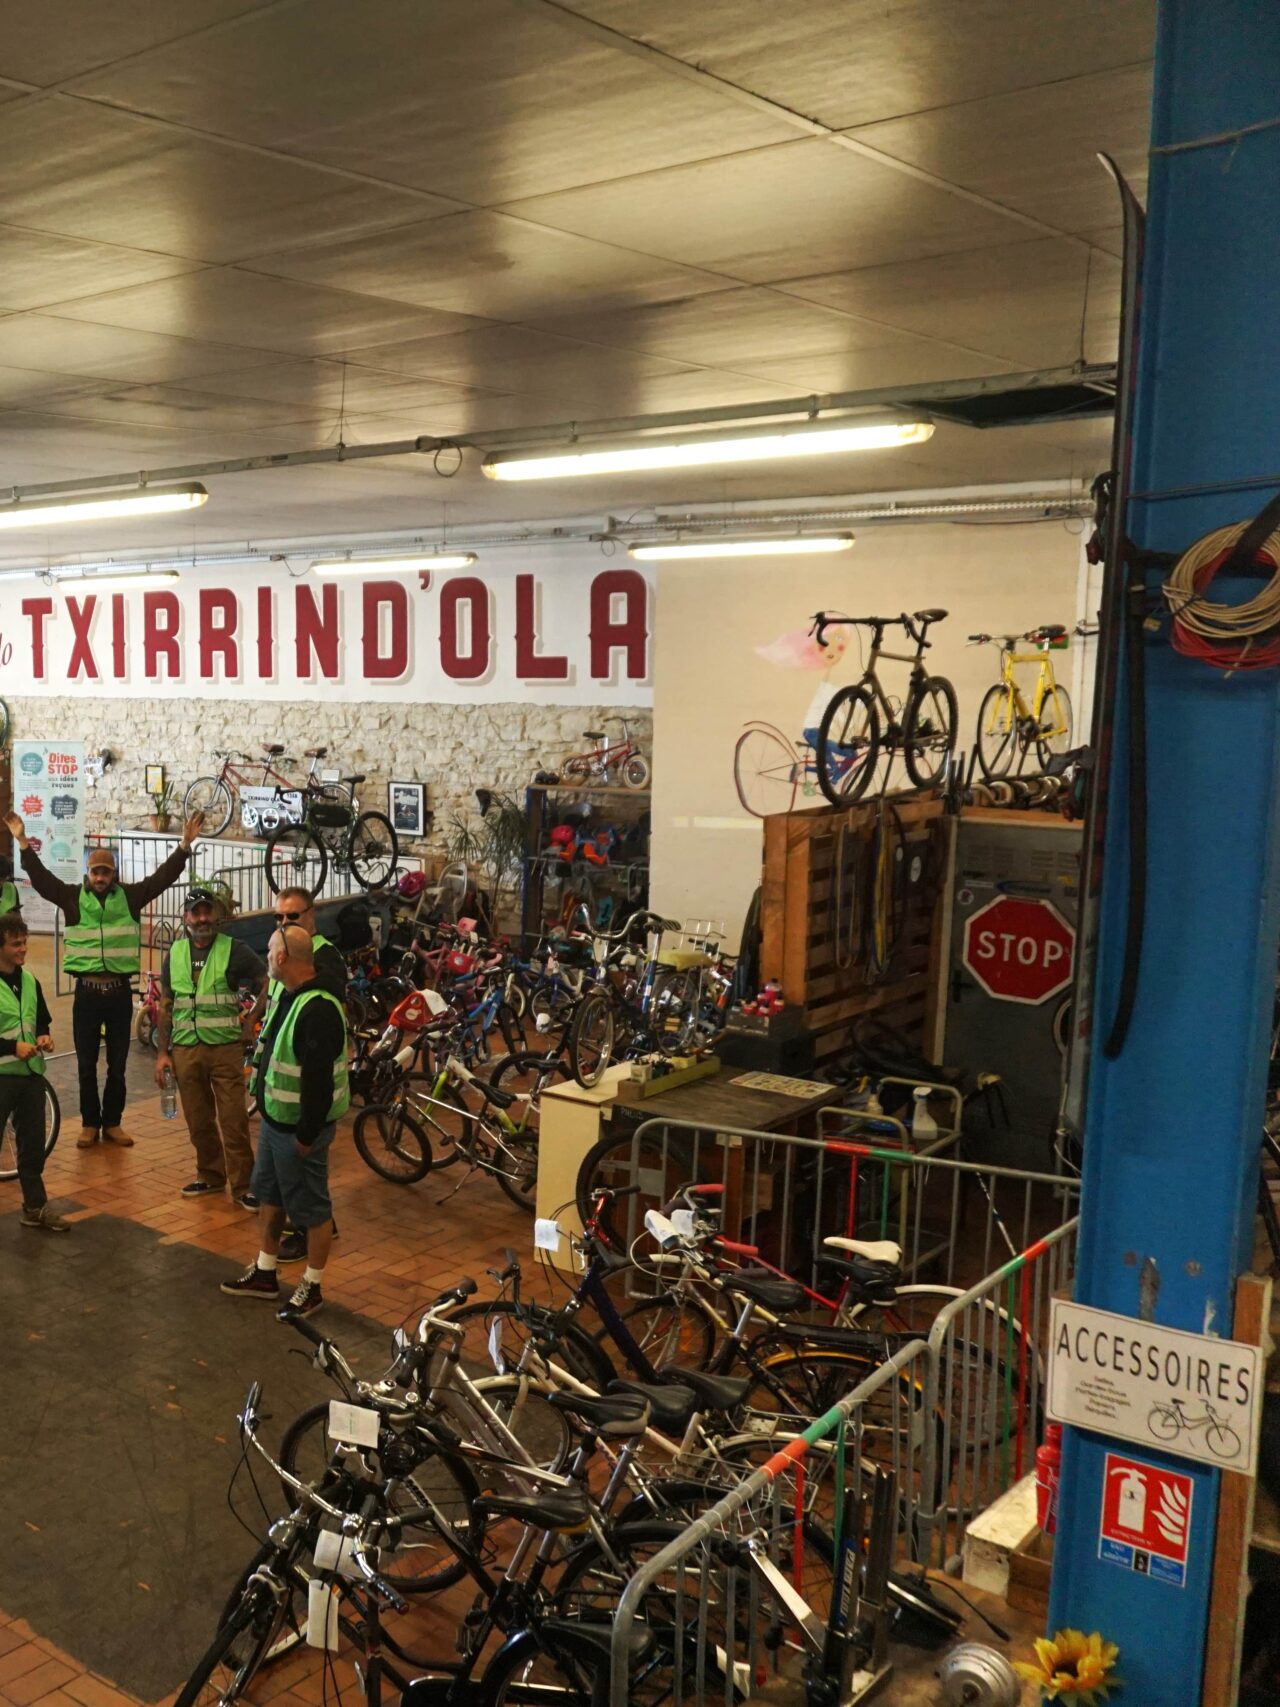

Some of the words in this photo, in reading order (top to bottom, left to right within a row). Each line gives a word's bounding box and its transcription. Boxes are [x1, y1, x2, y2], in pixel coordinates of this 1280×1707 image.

[22, 569, 647, 681] TXIRRIND'OLA
[48, 752, 77, 764] Dites
[48, 764, 79, 775] STOP
[977, 931, 1064, 968] STOP
[1056, 1322, 1250, 1406] ACCESSOIRES
